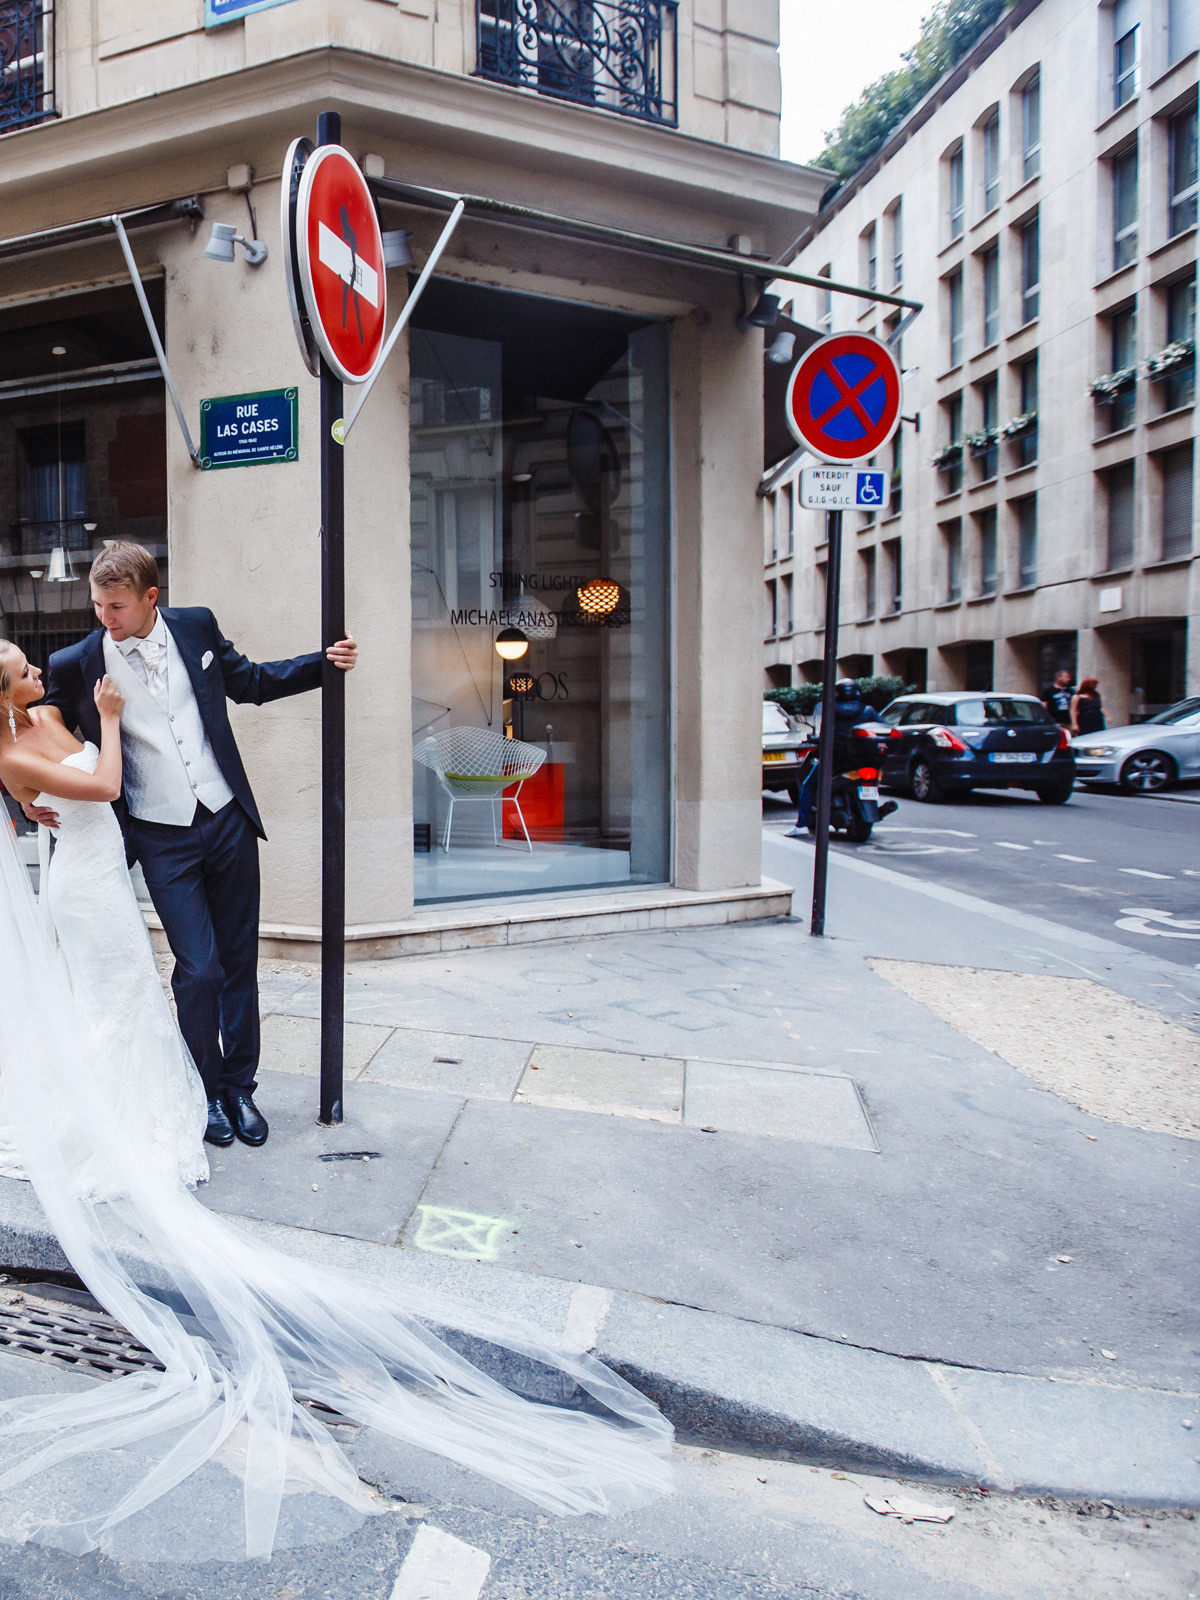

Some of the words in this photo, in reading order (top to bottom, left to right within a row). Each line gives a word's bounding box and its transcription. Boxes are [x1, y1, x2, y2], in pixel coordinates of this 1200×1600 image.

[236, 404, 259, 418] RUE
[217, 424, 238, 437] LAS
[241, 418, 279, 435] CASES
[812, 471, 850, 480] INTERDIT
[820, 483, 842, 492] SAUF
[489, 572, 538, 590] STRING
[450, 609, 513, 626] MICHAEL
